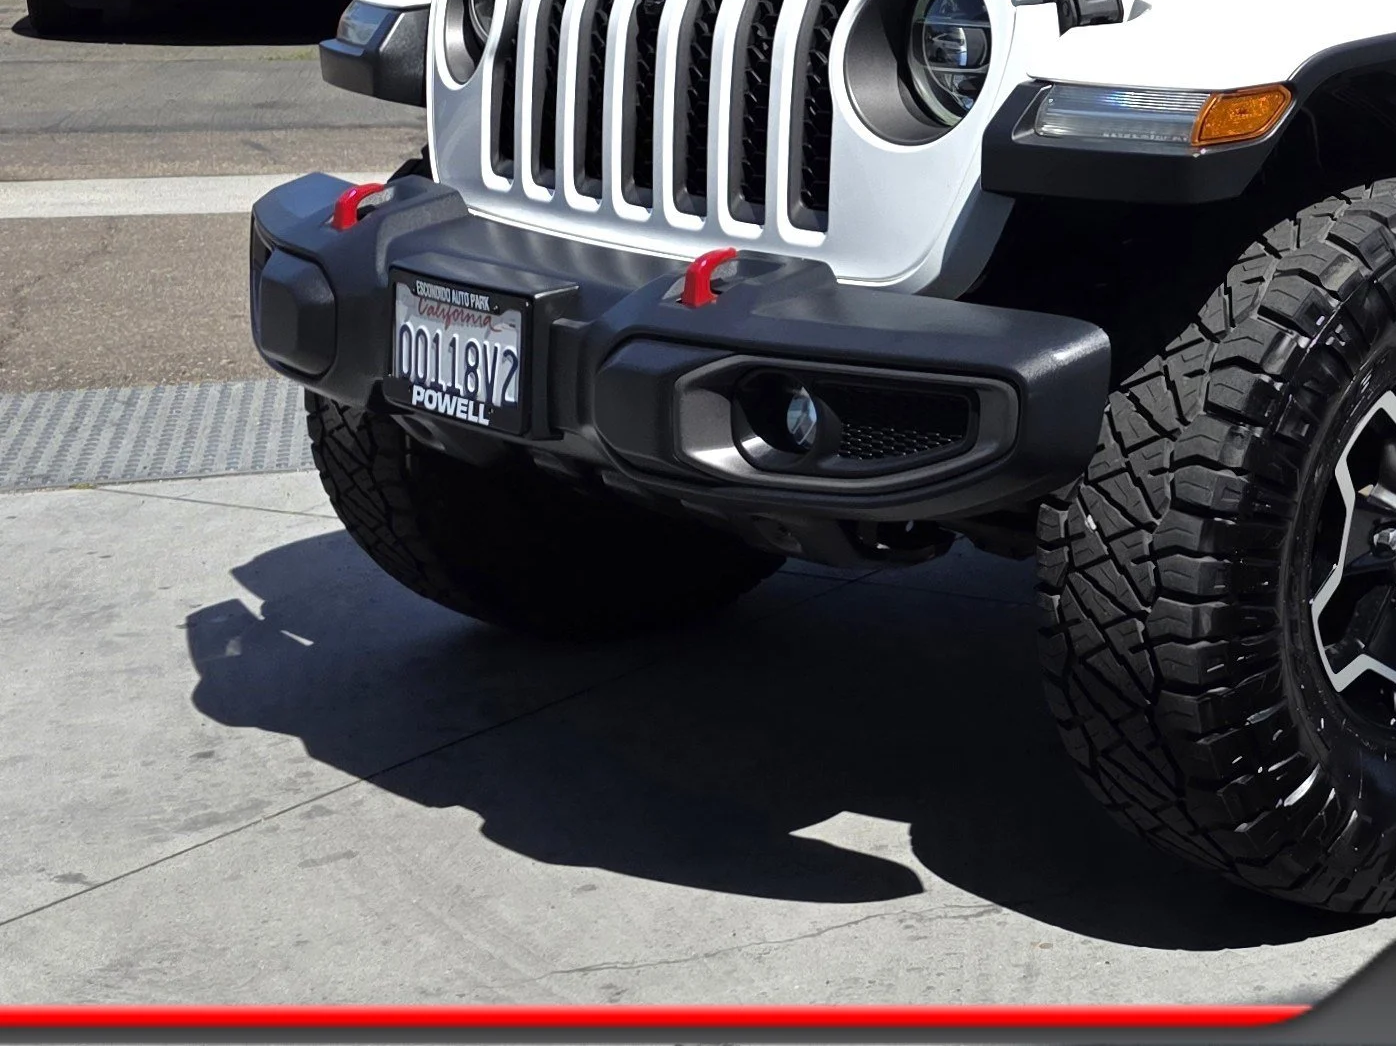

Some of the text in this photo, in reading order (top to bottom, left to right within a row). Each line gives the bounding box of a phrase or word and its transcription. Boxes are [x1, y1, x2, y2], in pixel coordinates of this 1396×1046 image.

[415, 279, 490, 312] ESCONDIDO AUTO PARK
[399, 322, 519, 408] 00118V2
[411, 384, 490, 426] POWELL
